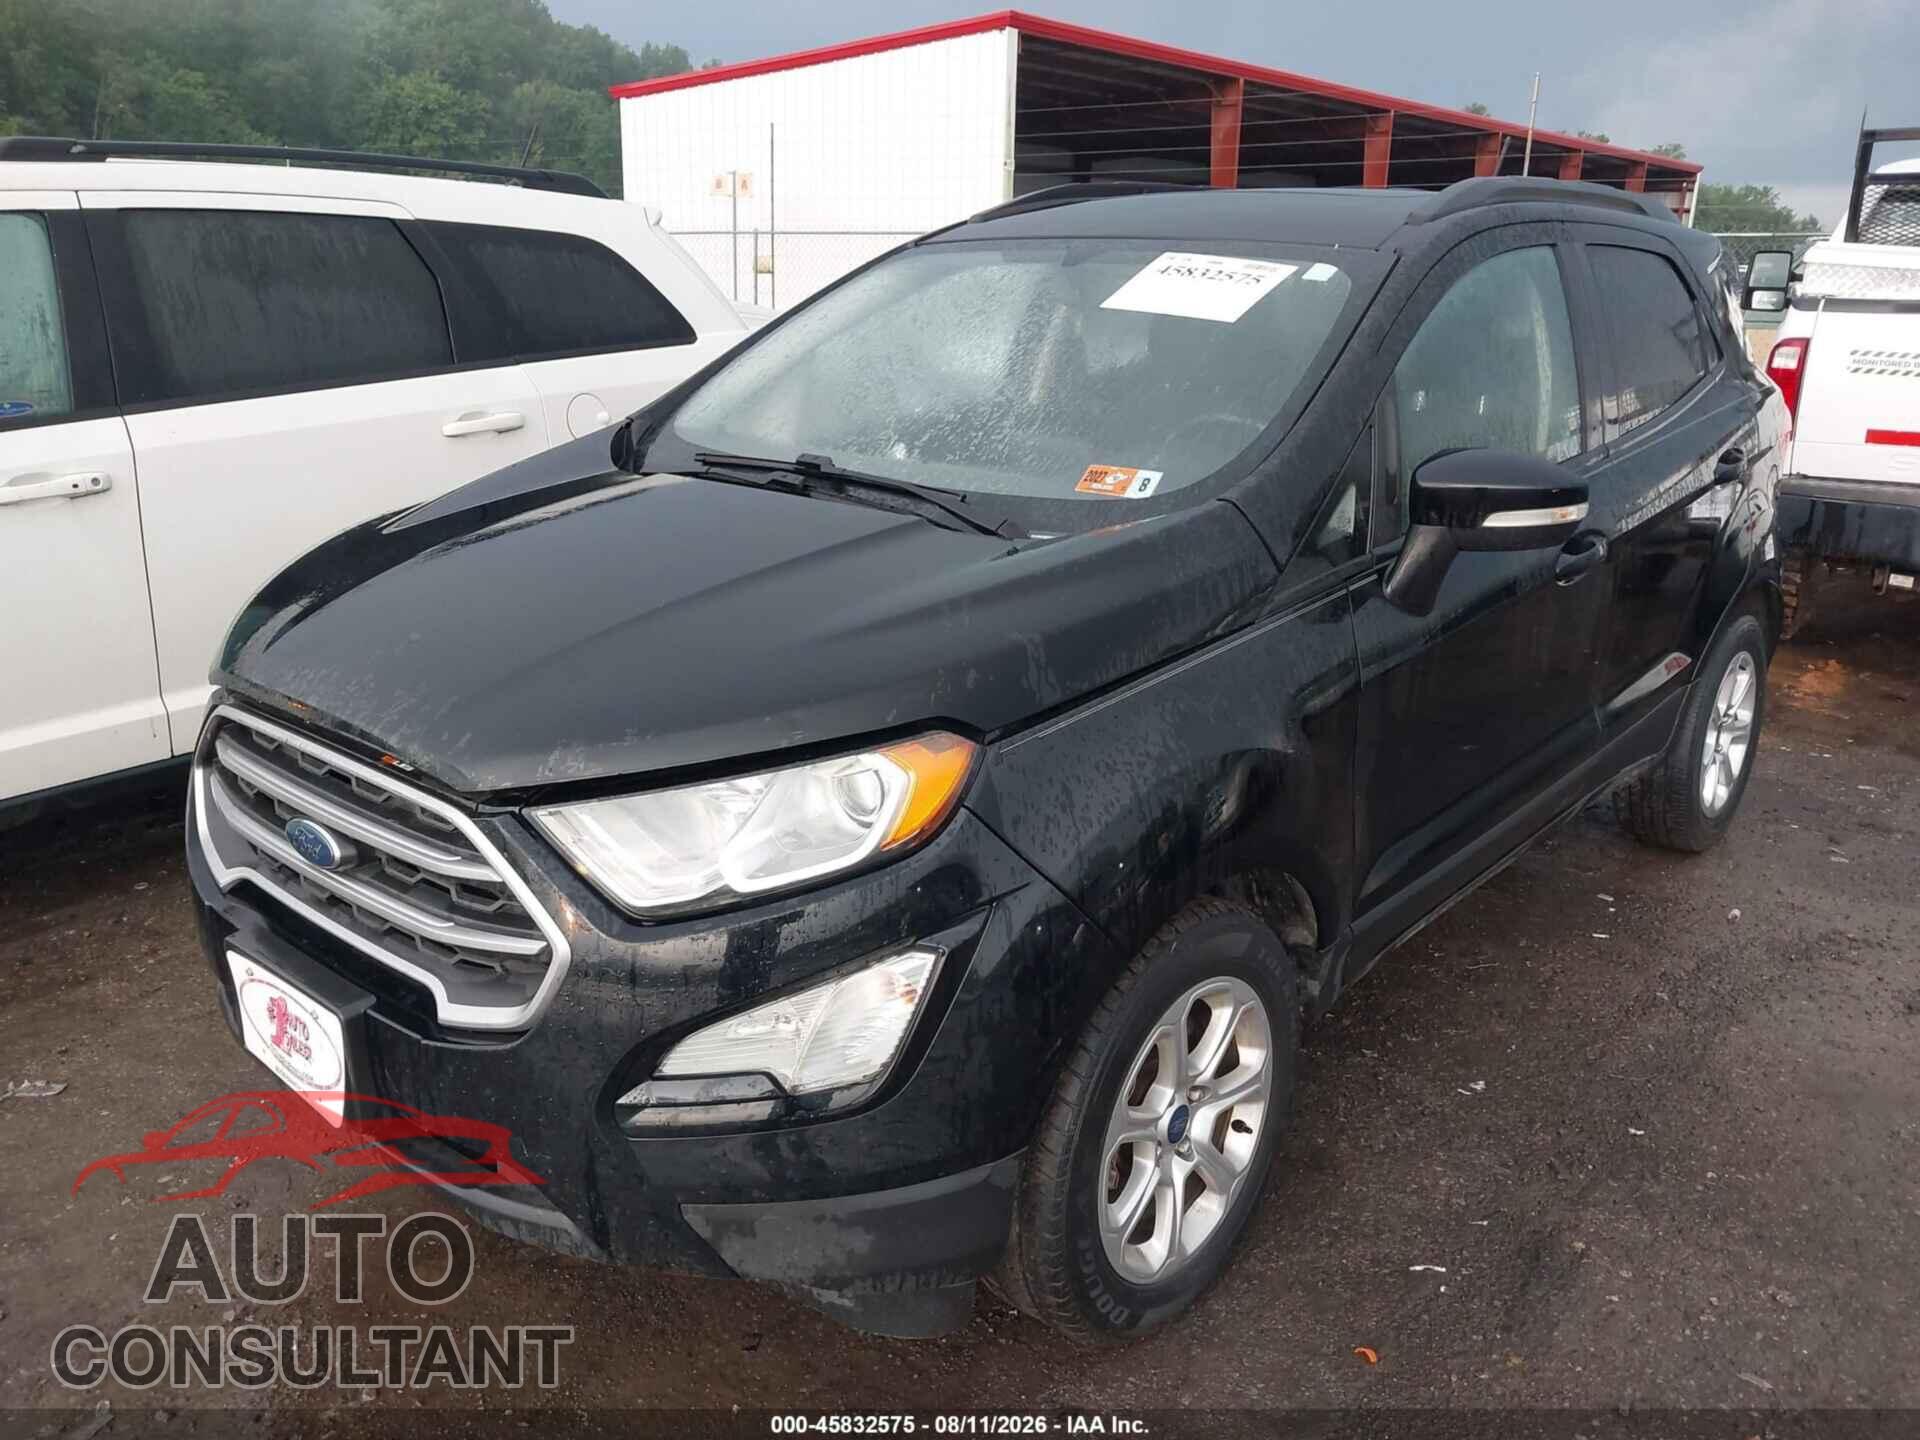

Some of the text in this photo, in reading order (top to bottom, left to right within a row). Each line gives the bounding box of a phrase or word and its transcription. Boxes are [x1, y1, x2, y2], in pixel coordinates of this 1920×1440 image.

[1158, 264, 1266, 286] 45832575
[1852, 358, 1912, 369] MONITORED
[295, 826, 323, 861] Ford
